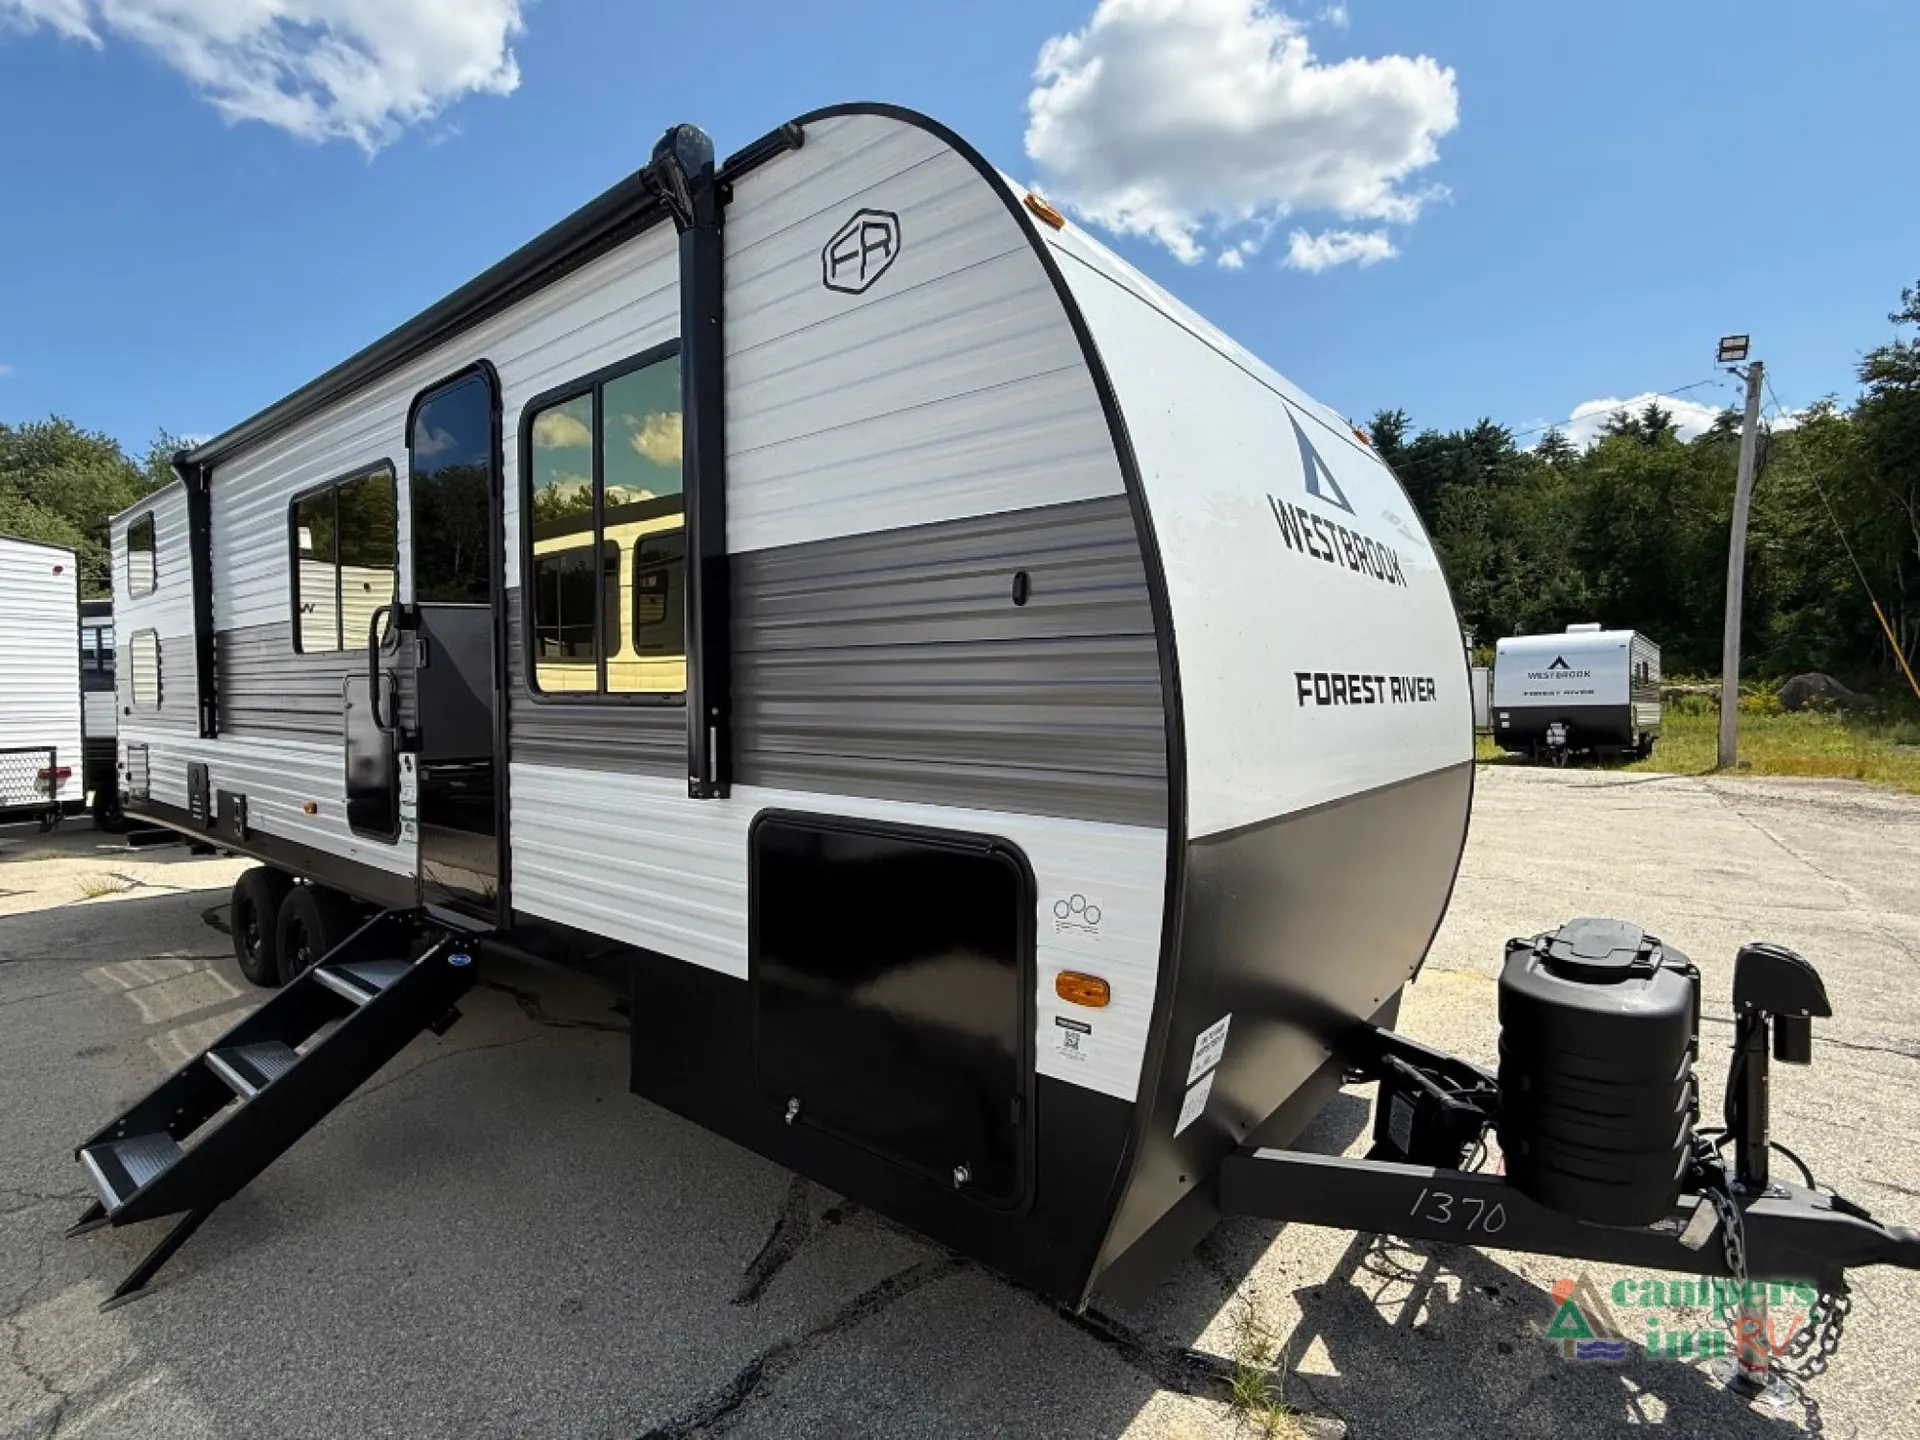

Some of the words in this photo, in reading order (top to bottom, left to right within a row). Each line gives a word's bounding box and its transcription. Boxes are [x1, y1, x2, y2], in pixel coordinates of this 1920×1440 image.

[1266, 493, 1408, 588] WESTBROOK
[1294, 671, 1386, 707] FOREST
[1389, 676, 1437, 704] RIVER
[1527, 670, 1591, 680] WESTBROOK
[1409, 1188, 1507, 1233] 1370
